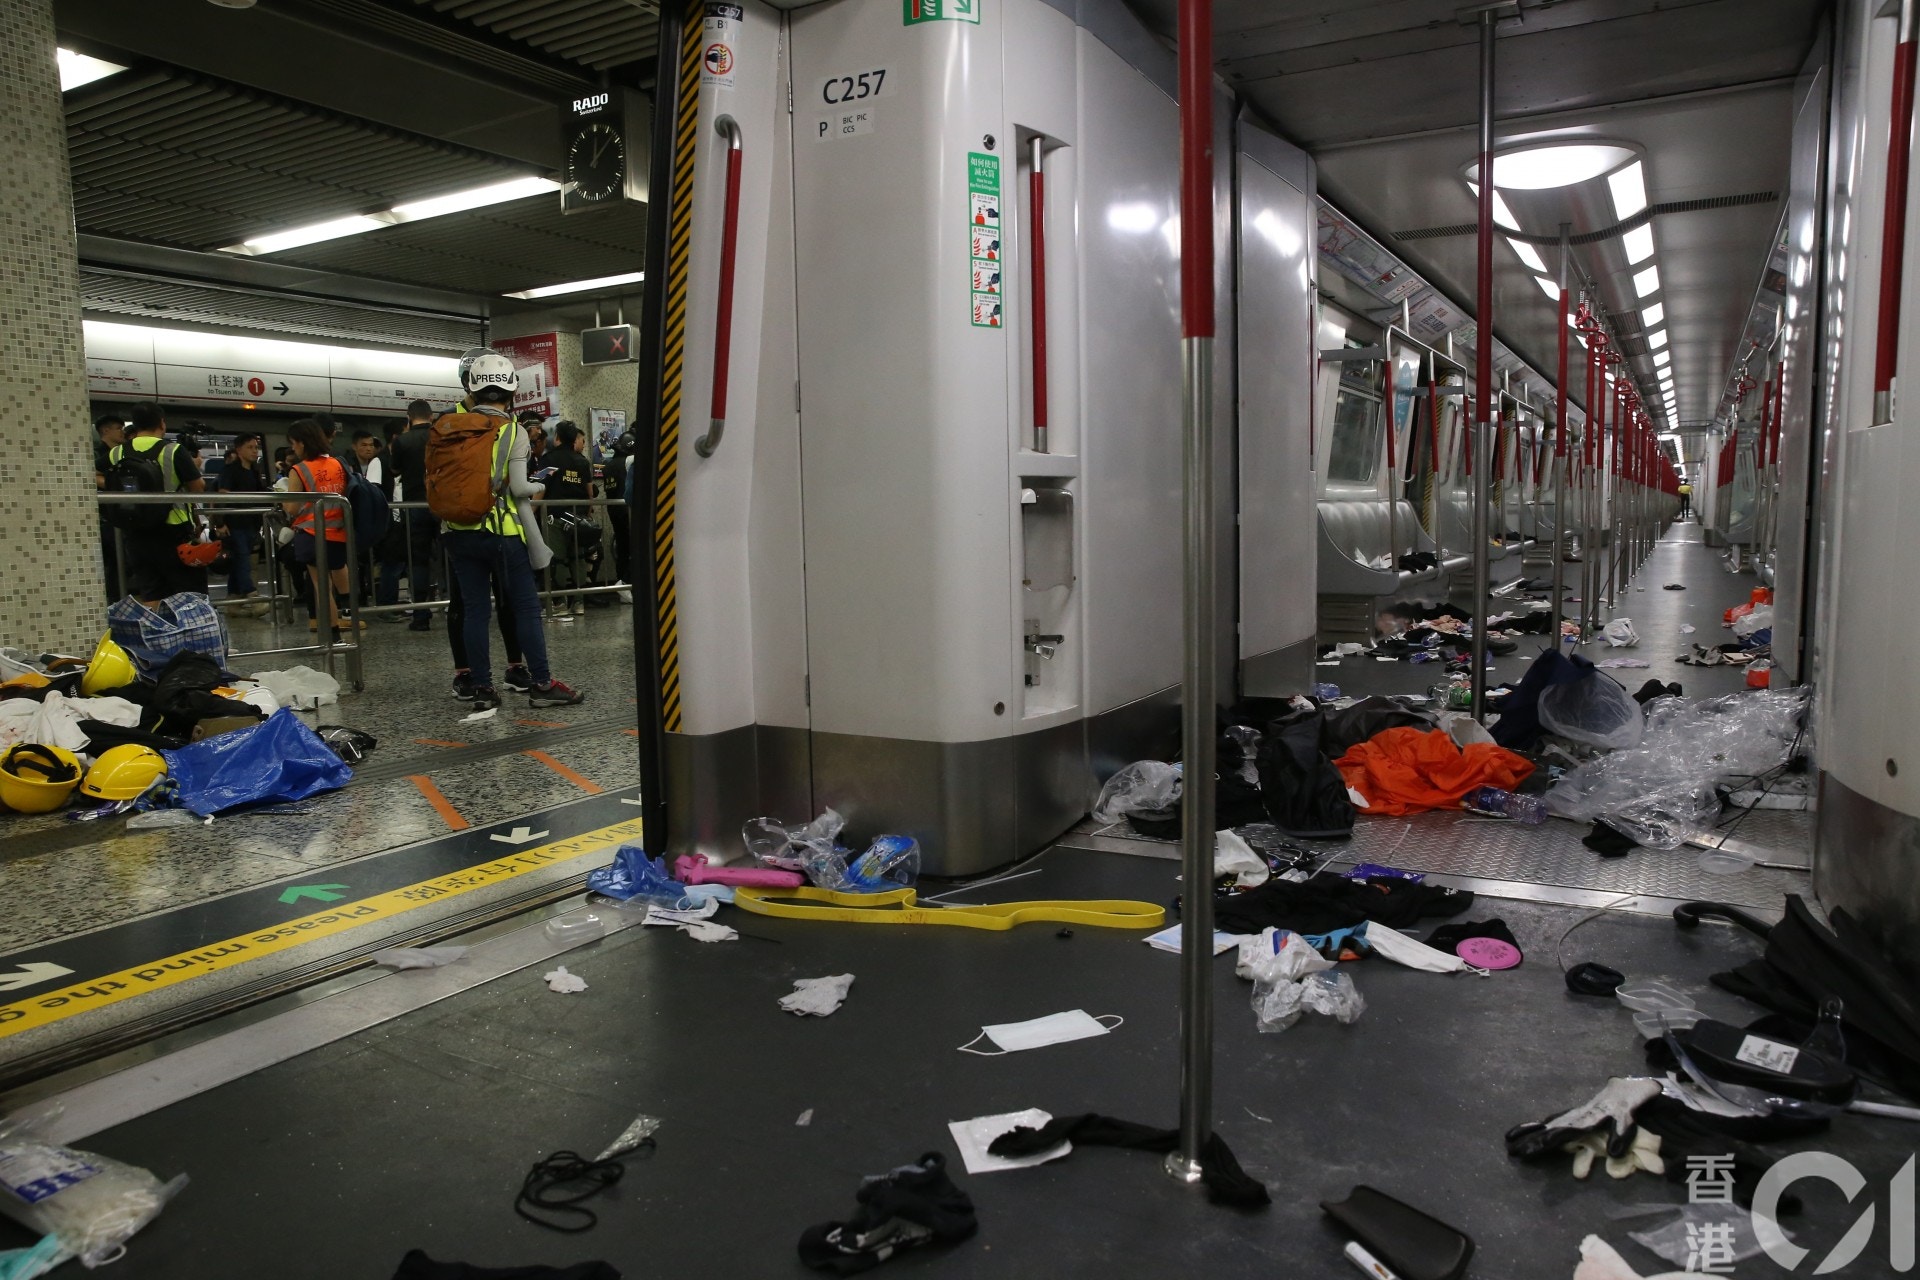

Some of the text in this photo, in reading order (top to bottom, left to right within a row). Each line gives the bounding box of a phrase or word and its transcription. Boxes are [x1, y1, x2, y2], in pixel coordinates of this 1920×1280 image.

[717, 5, 740, 17] C257
[823, 69, 886, 104] C257
[573, 93, 608, 112] RADO
[842, 113, 867, 124] BIC PIC
[819, 122, 828, 137] P
[843, 125, 855, 133] CCS
[970, 157, 998, 169] 如何使用
[208, 374, 243, 388] 往荃灣
[476, 374, 508, 383] PRESS
[253, 381, 259, 393] 1
[562, 475, 582, 484] POLICE
[252, 905, 379, 943] Please
[132, 943, 248, 981] mind
[37, 981, 128, 1008] the
